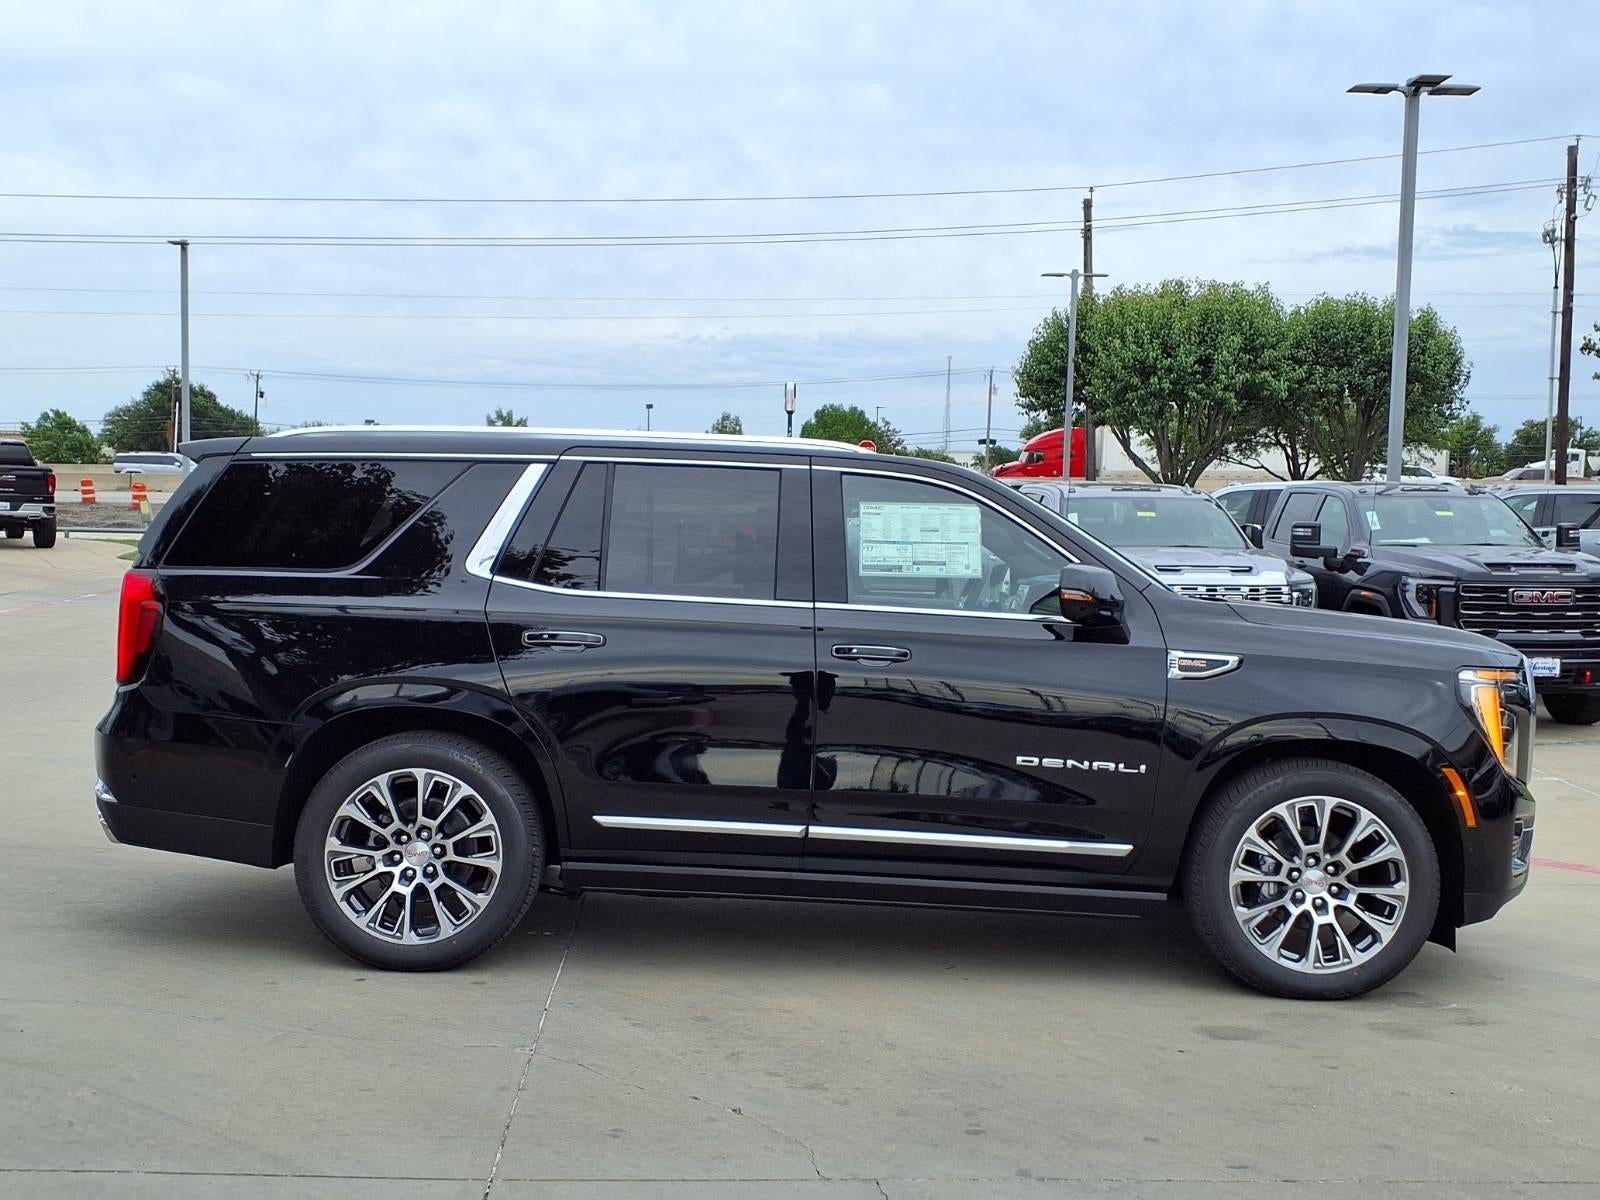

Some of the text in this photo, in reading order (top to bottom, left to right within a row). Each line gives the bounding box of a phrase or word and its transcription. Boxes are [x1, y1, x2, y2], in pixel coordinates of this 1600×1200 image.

[1514, 591, 1572, 603] GMC
[1178, 659, 1207, 667] GMC
[1016, 755, 1146, 774] DENALI
